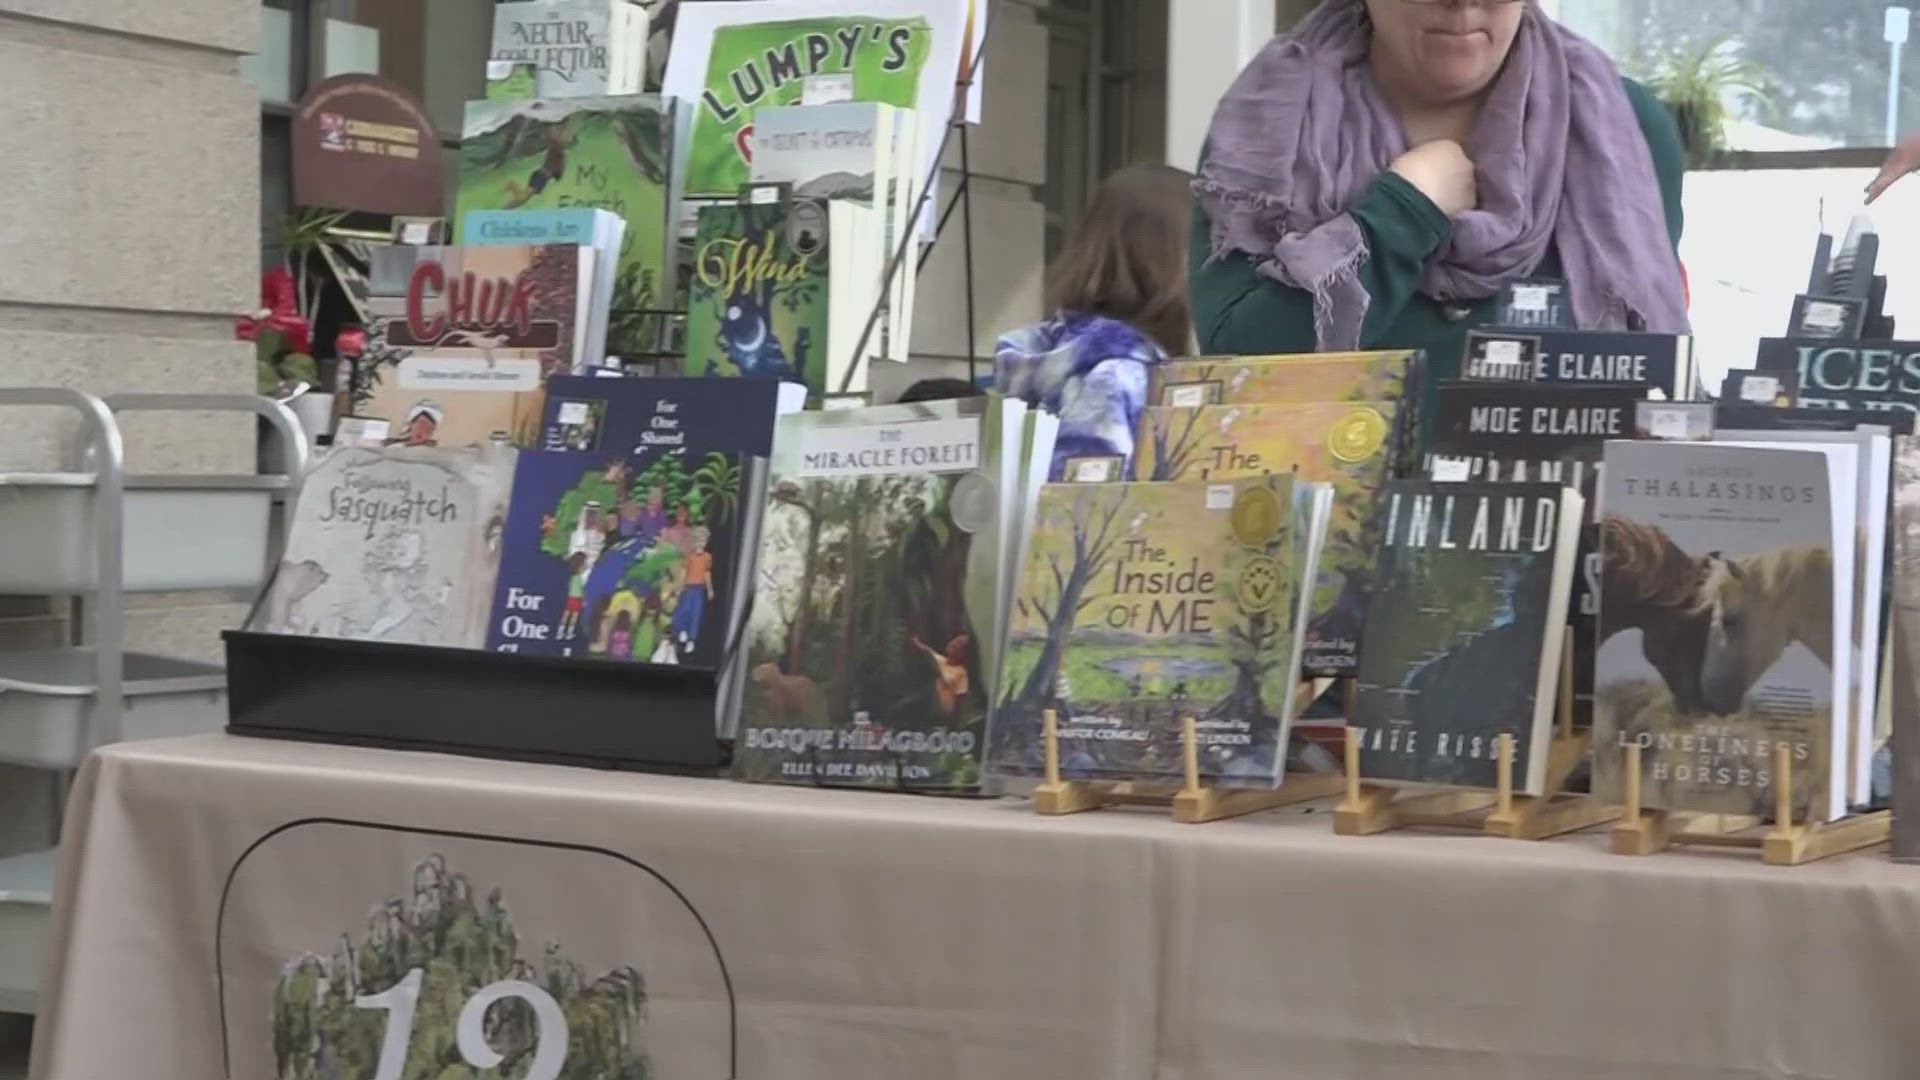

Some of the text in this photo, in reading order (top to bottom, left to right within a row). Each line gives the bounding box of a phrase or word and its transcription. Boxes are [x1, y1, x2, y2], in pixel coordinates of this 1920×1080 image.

[511, 20, 595, 46] NECTAR
[702, 25, 910, 121] LUMPY'S
[697, 228, 810, 300] Wind
[1557, 353, 1648, 381] CLAIRE
[656, 400, 678, 412] For
[651, 416, 679, 429] One
[1470, 406, 1622, 435] MOE CLAIRE
[804, 442, 974, 469] MIRACLE FOREST
[1211, 443, 1260, 471] The
[1624, 478, 1815, 504] THALASINOS
[318, 485, 457, 541] Sasquatch
[1384, 493, 1556, 553] INLAND
[1125, 537, 1167, 563] The
[1112, 556, 1215, 594] Inside
[506, 587, 545, 611] For
[502, 615, 549, 640] One
[1145, 599, 1216, 634] ME
[1653, 763, 1771, 788] HORSES
